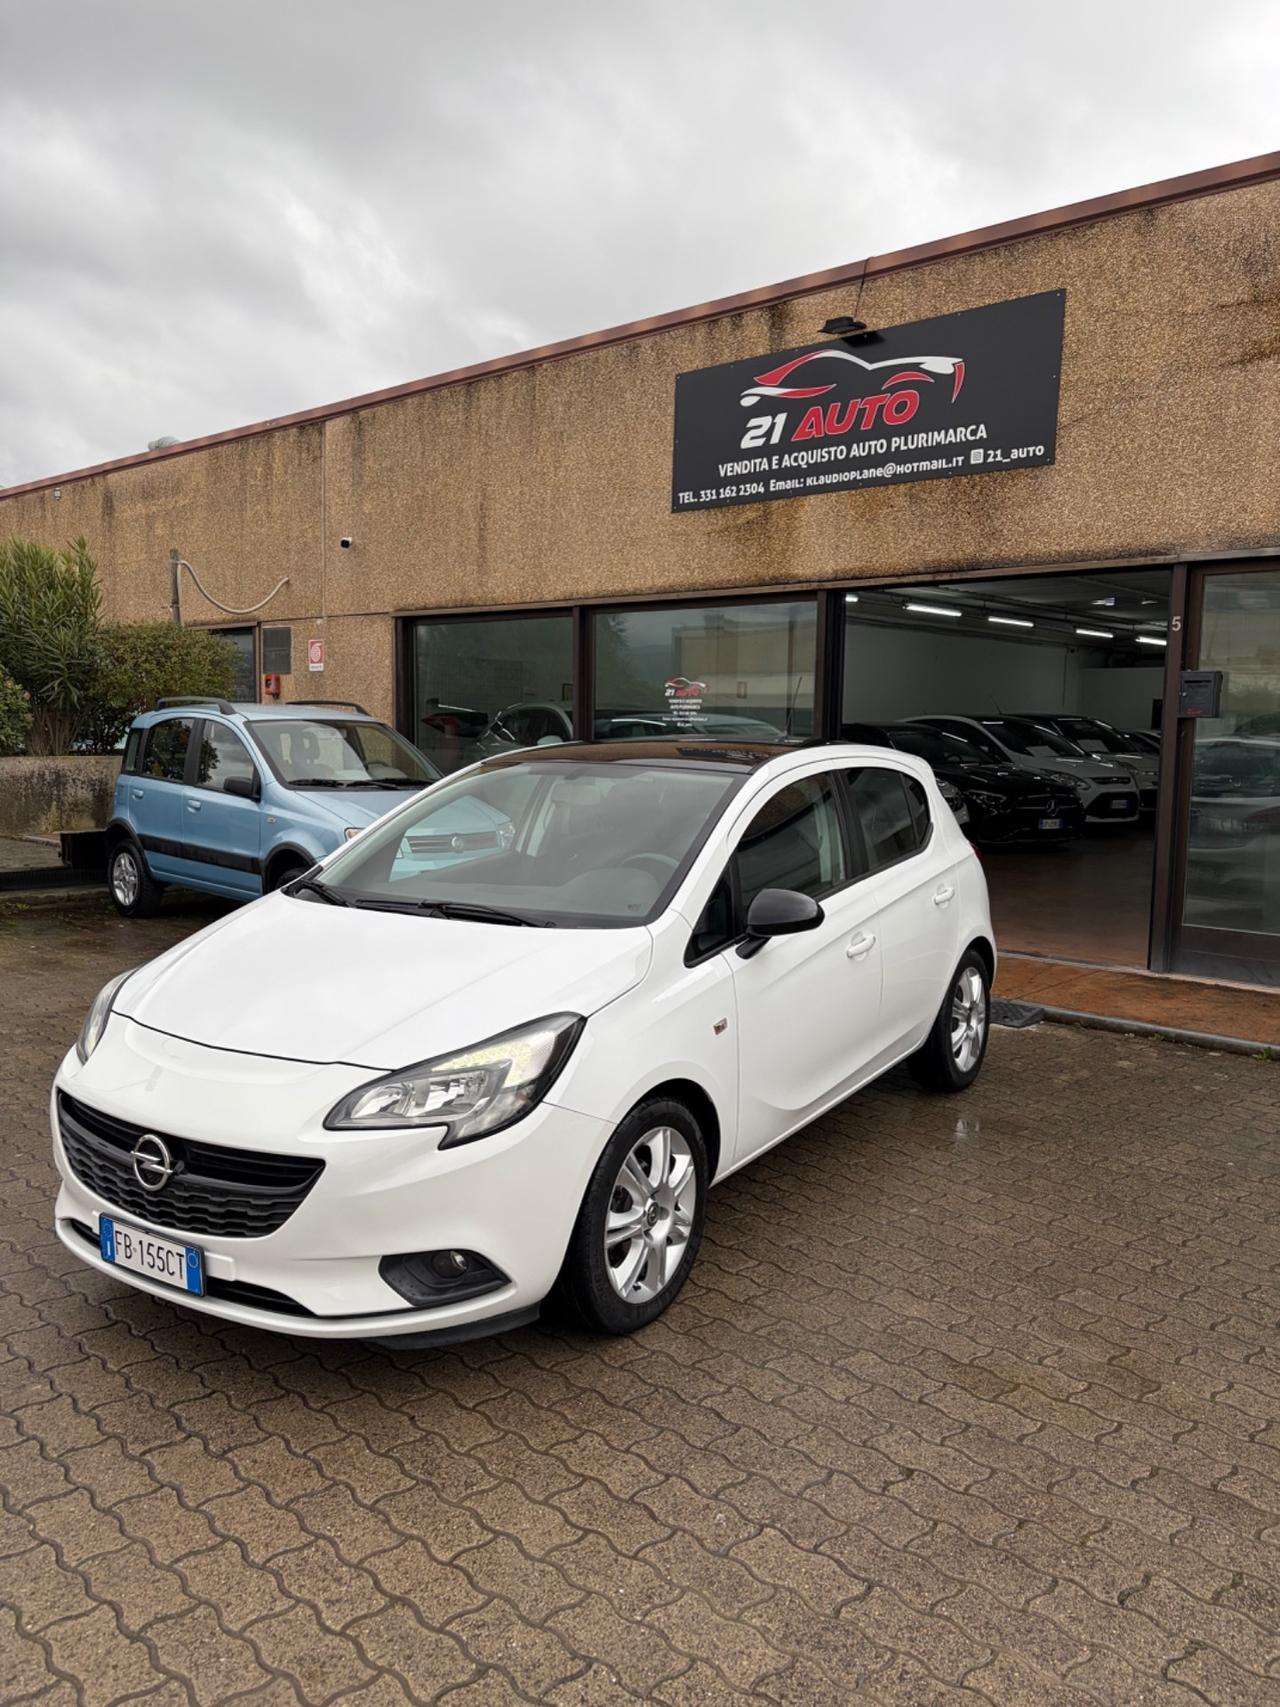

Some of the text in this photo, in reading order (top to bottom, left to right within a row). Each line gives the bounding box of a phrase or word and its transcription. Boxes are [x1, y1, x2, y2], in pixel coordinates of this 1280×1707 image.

[740, 389, 920, 449] 21 AUTO
[718, 424, 988, 478] VENDITA E ACQUISTO AUTO PLURIMARCA
[678, 491, 698, 504] TEL.
[699, 488, 717, 502] 331
[719, 486, 737, 499] 162
[738, 482, 765, 496] 2304
[769, 477, 804, 492] Email:
[1171, 615, 1182, 631] 5
